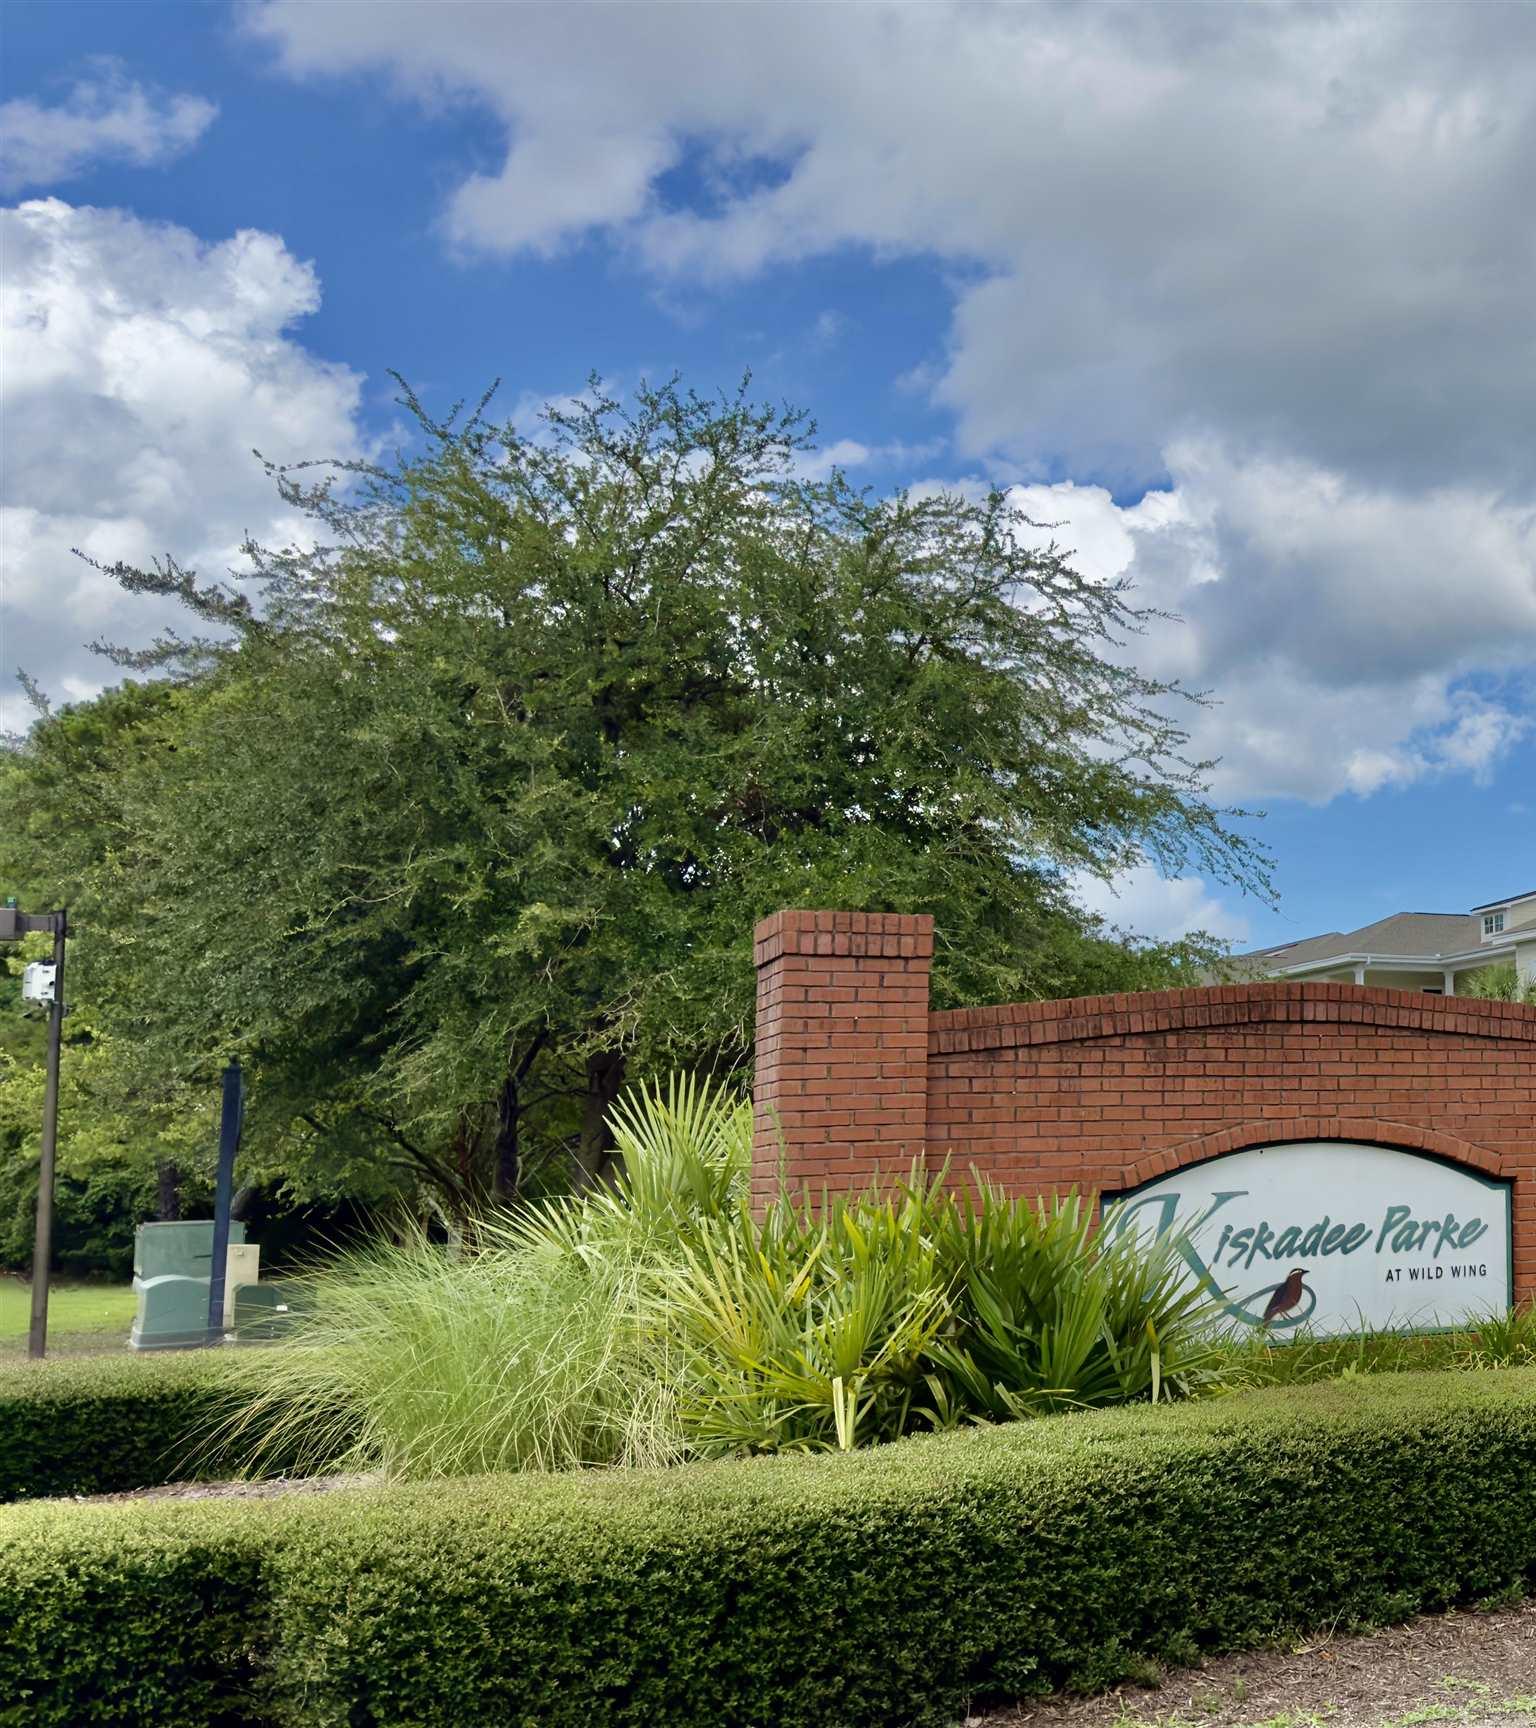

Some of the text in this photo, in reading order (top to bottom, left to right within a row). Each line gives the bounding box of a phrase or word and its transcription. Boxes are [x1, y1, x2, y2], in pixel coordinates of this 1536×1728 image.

[1375, 1205, 1489, 1259] Parke
[1385, 1264, 1487, 1282] AT WILD WING
